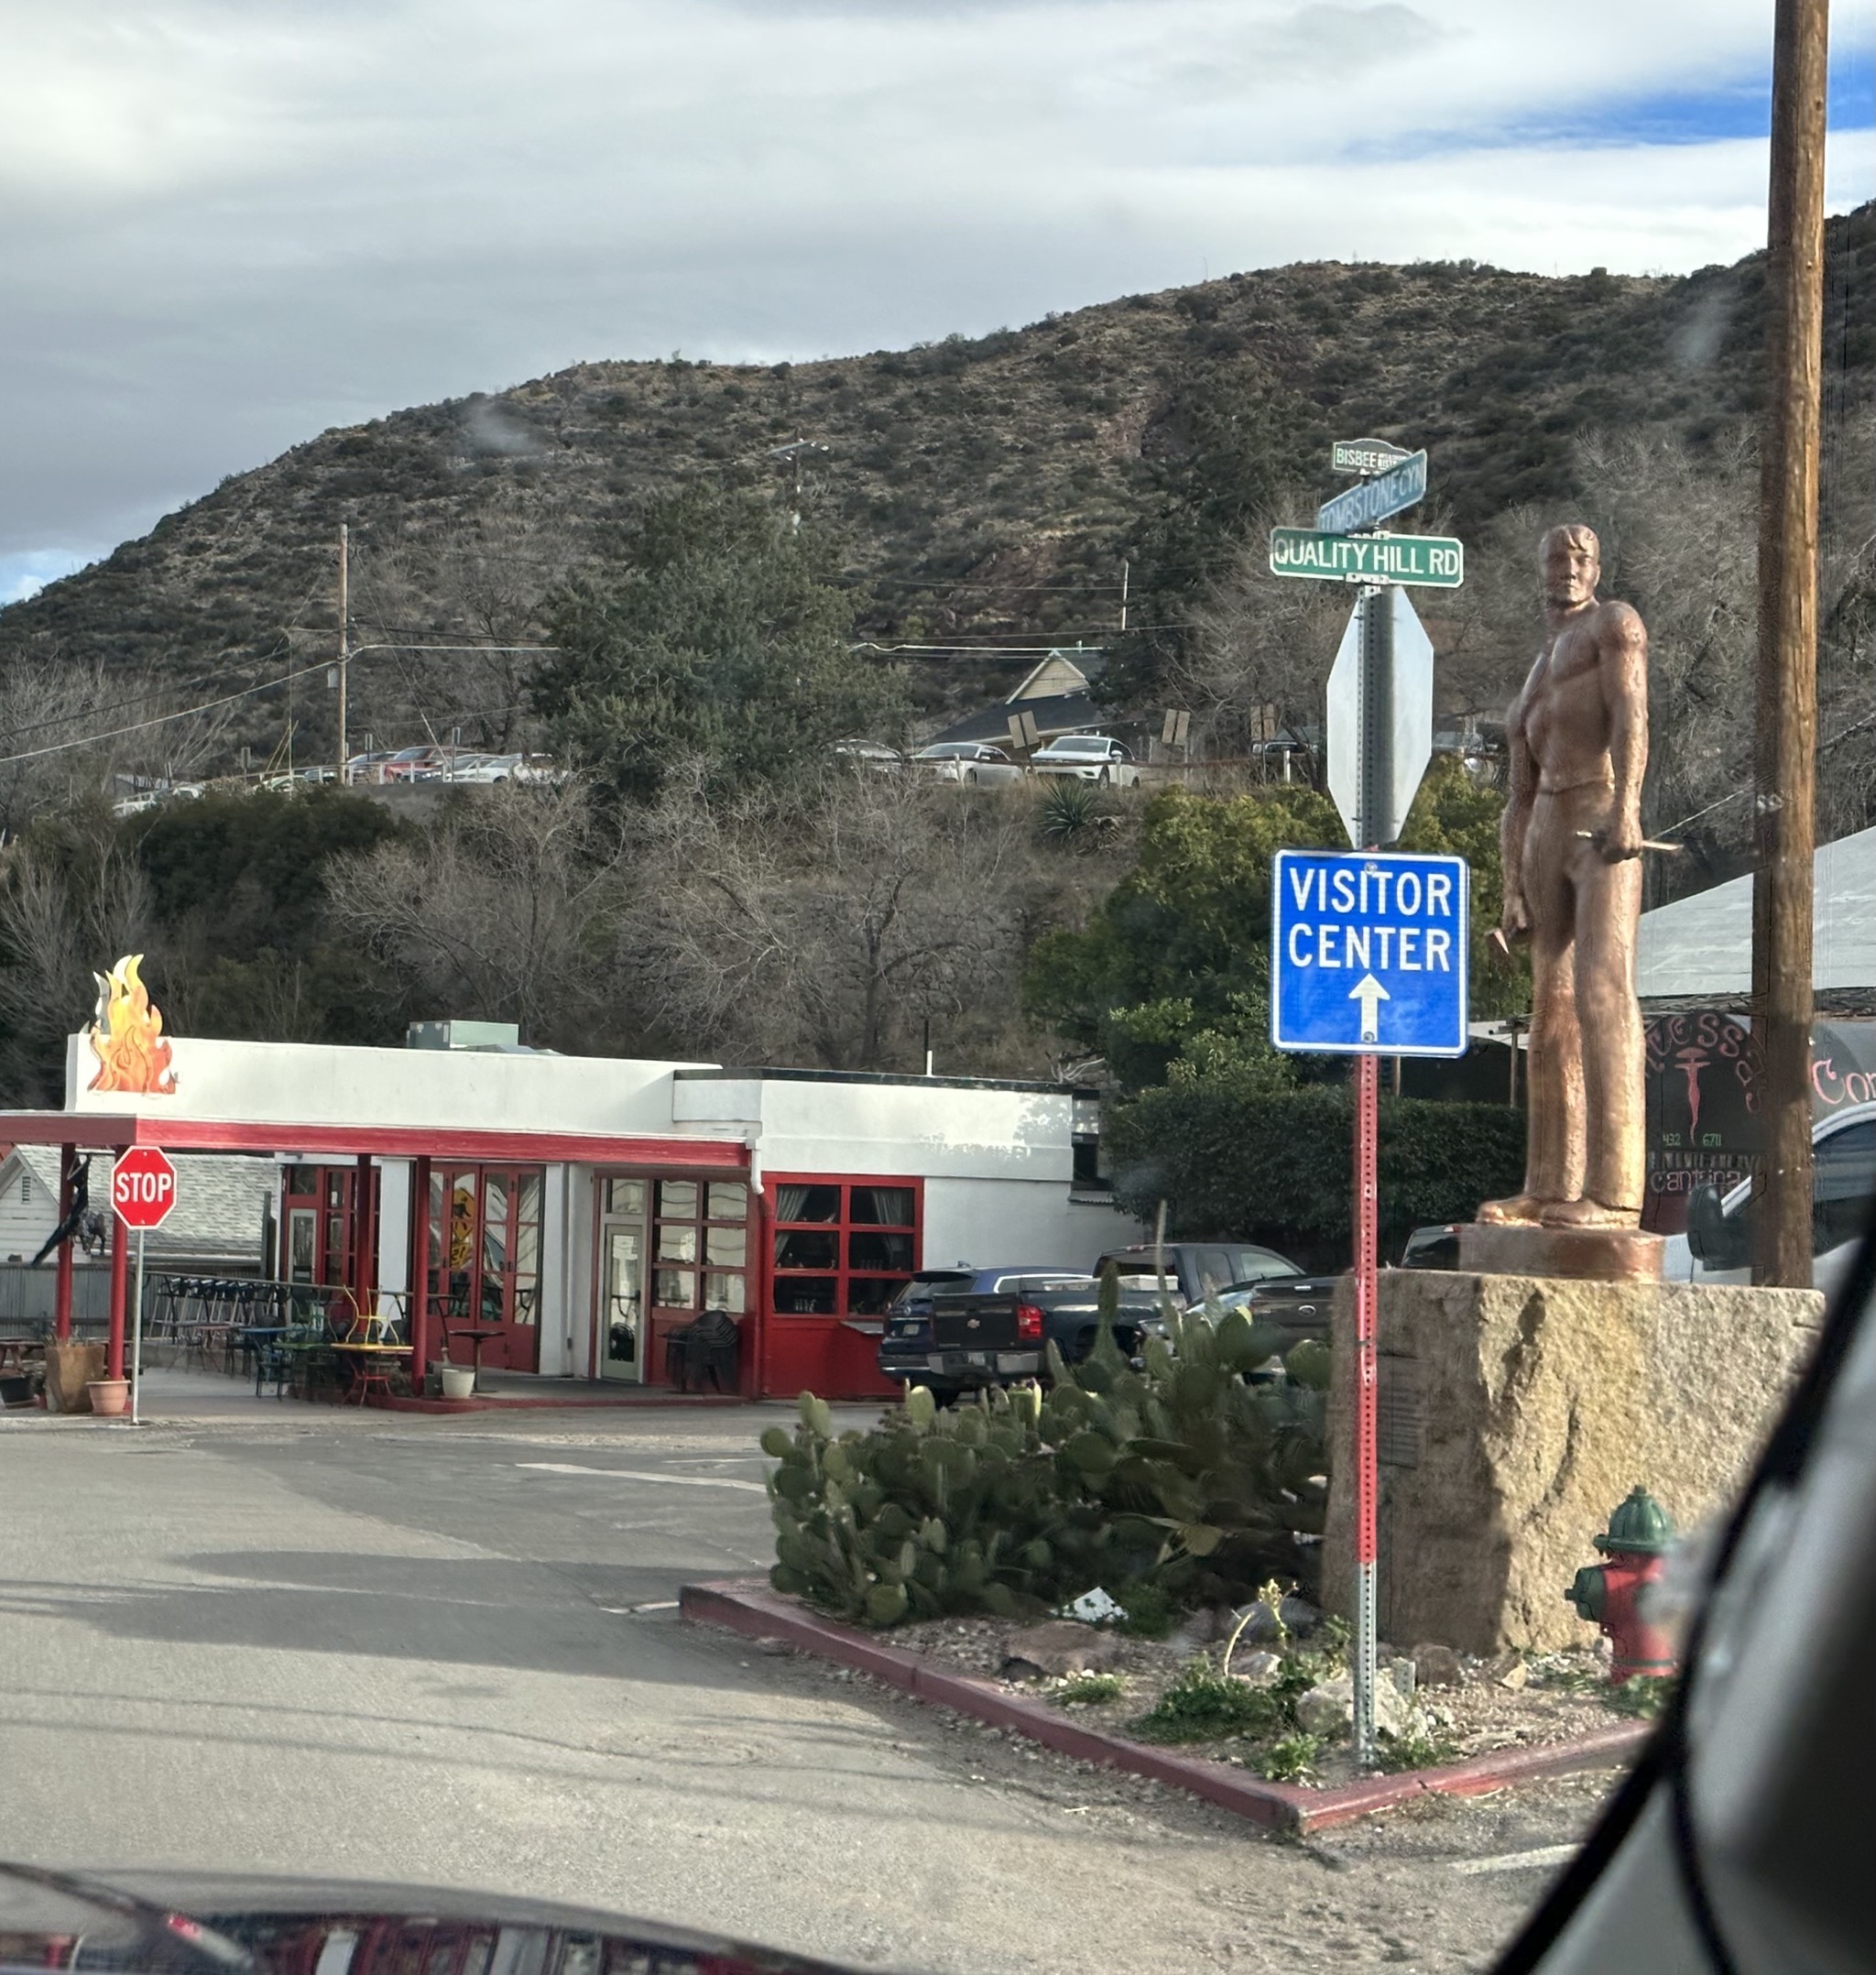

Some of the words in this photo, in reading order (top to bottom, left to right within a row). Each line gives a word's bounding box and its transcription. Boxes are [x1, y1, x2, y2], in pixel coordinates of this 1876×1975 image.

[1336, 447, 1376, 469] BISBEE
[1319, 473, 1399, 531] TOMBSTONE
[1274, 539, 1368, 571] QUALITY
[1373, 546, 1423, 574] HILL
[1429, 548, 1458, 576] RD
[1289, 867, 1451, 916] VISITOR
[1288, 922, 1451, 972] CENTER
[115, 1172, 172, 1203] STOP
